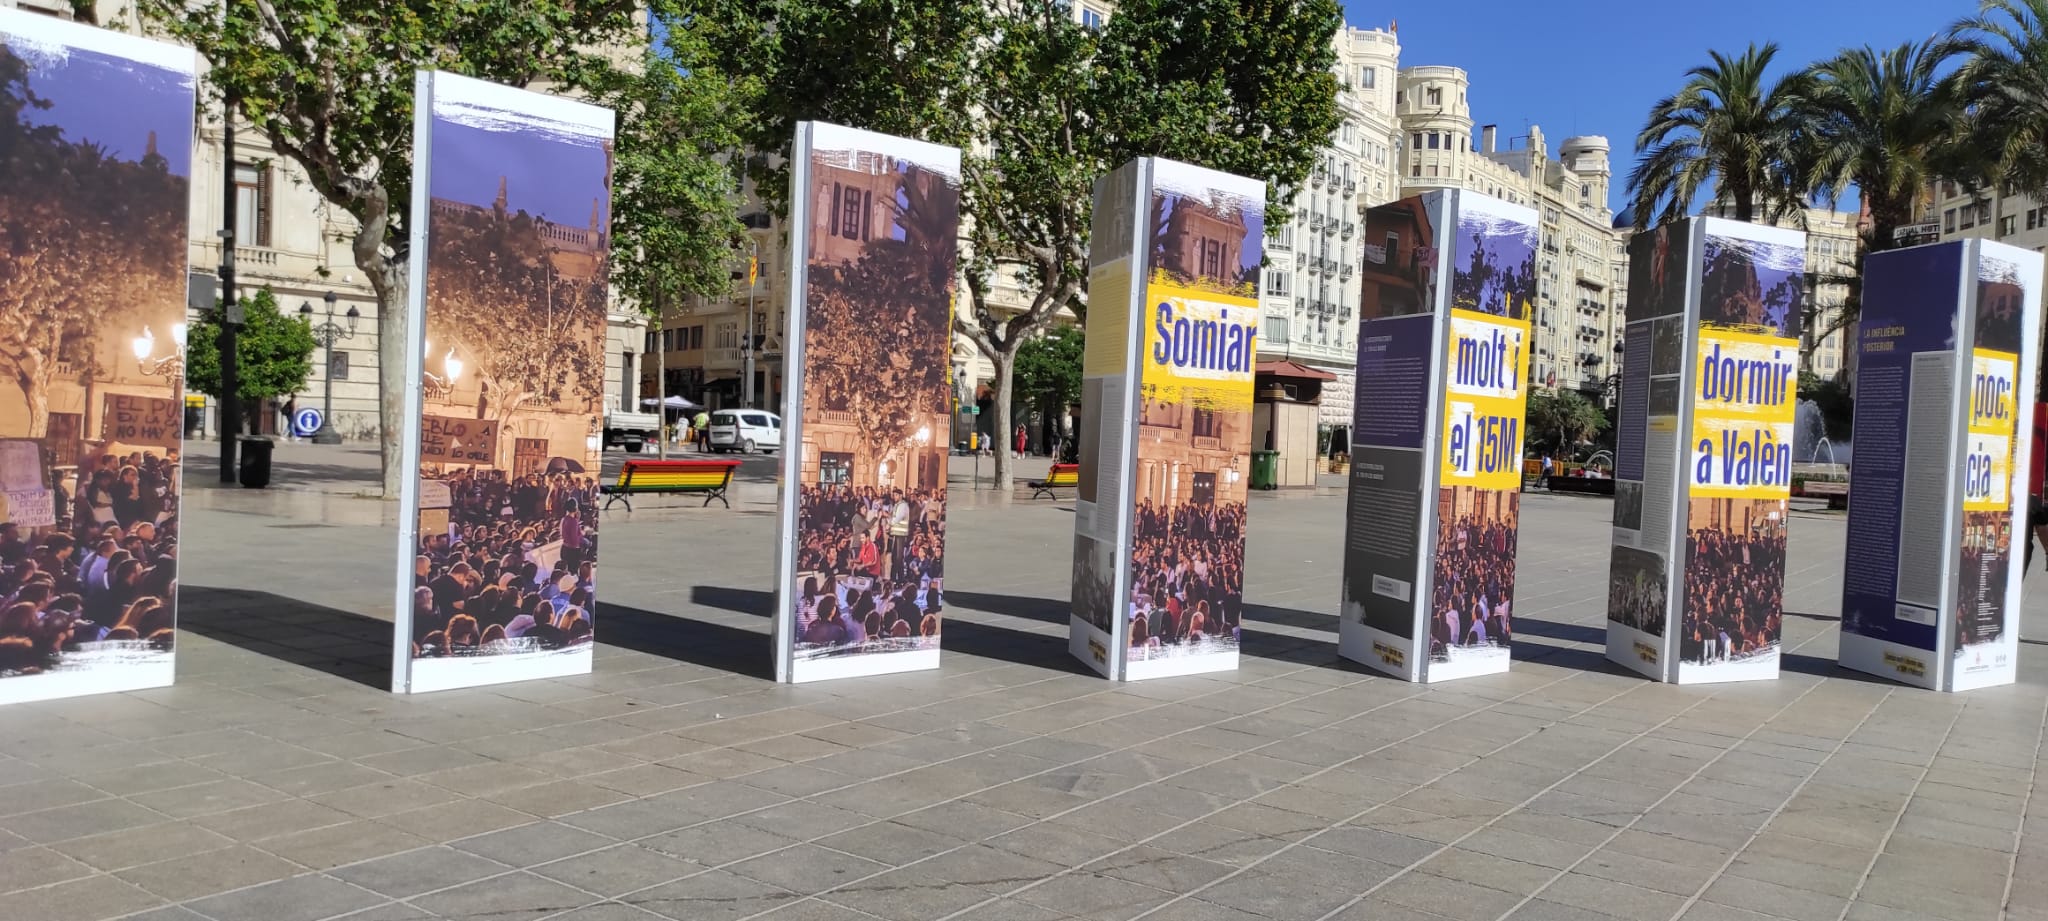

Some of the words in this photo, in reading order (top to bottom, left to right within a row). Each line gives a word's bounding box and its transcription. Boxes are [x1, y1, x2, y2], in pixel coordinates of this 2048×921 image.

[1921, 224, 1940, 233] HOT
[1153, 302, 1257, 373] Somiar
[1456, 329, 1507, 389] molt
[1512, 333, 1521, 391] i
[1703, 343, 1793, 406] dormir
[1973, 372, 2011, 424] poc:
[1450, 411, 1472, 472] el
[1477, 415, 1518, 474] 15M
[1696, 438, 1713, 484] a
[1722, 429, 1790, 487] Valèn
[1965, 442, 1991, 498] cia
